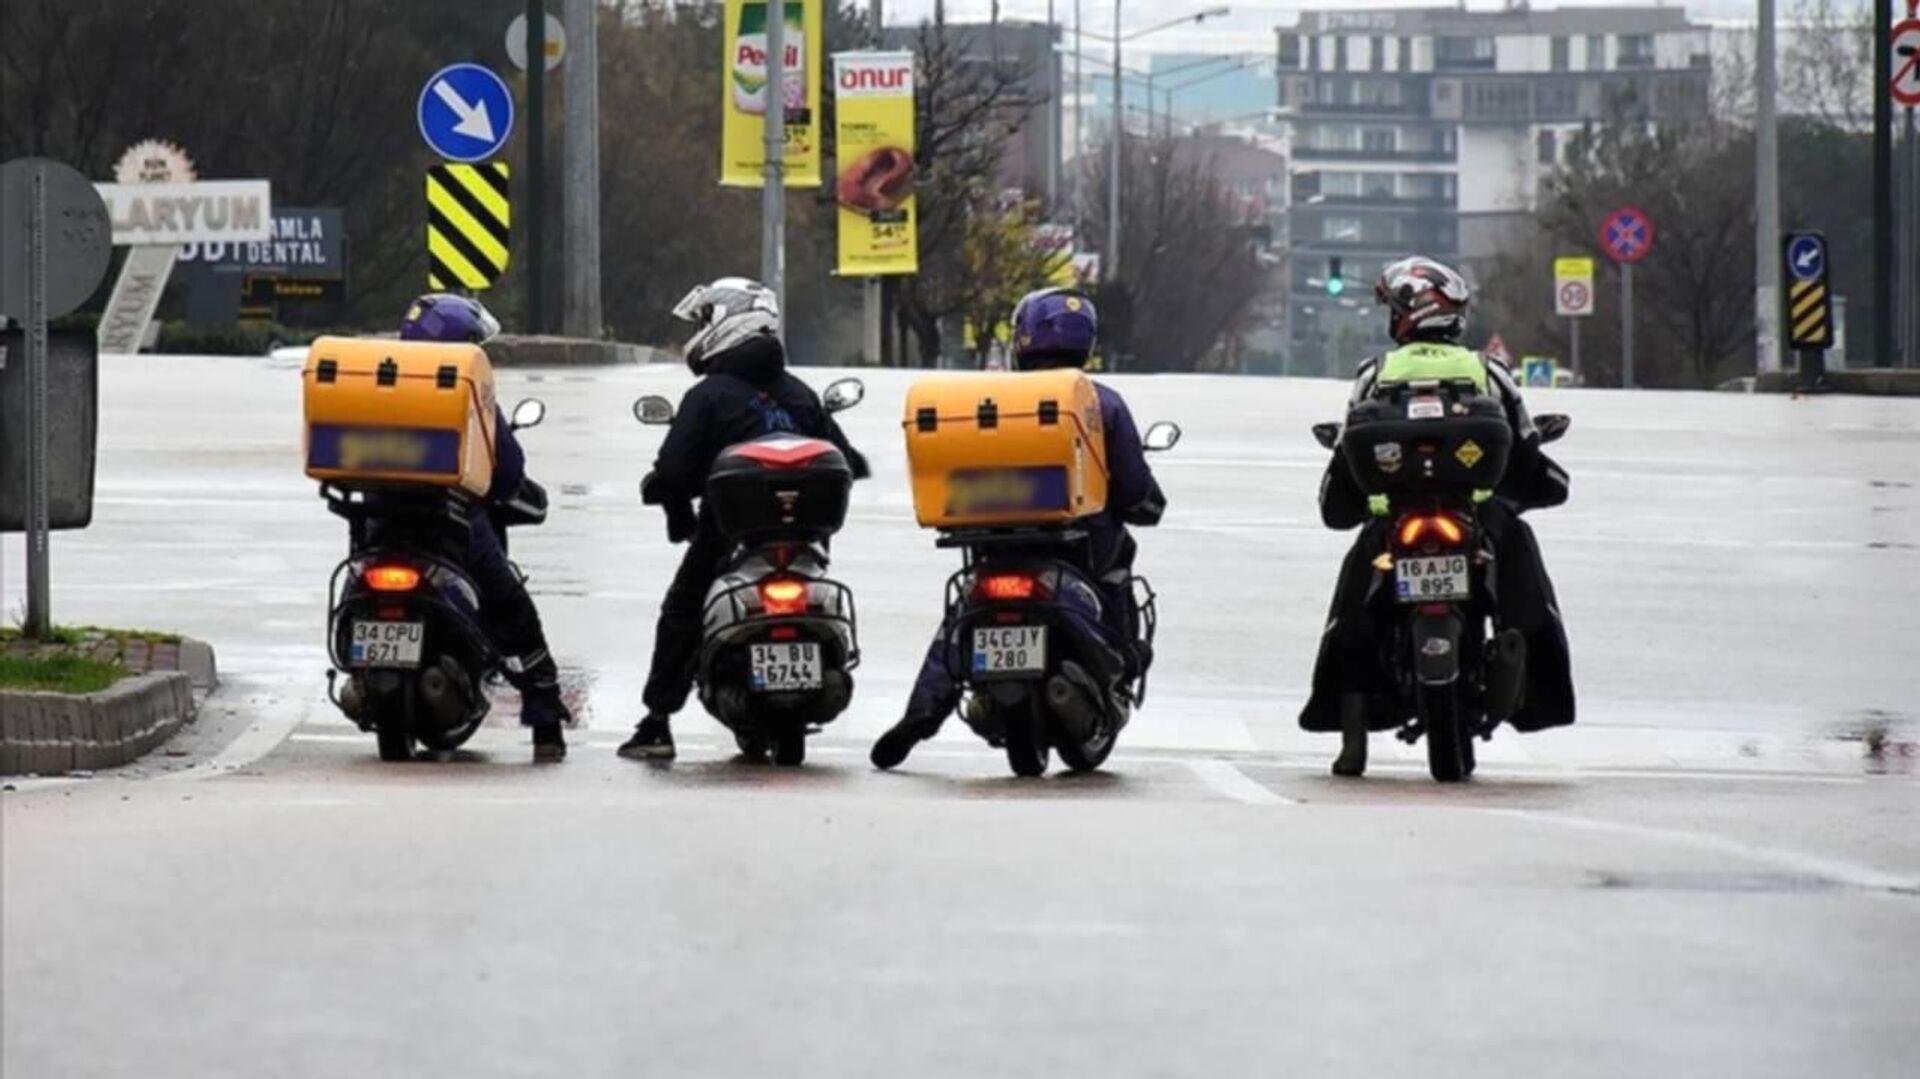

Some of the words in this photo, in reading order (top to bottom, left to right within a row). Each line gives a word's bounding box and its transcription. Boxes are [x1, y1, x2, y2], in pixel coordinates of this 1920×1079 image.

[738, 45, 798, 67] Peil
[841, 67, 909, 89] onur
[248, 242, 326, 263] DENTAL
[1401, 560, 1422, 577] 16
[357, 624, 378, 640] 34
[384, 624, 420, 642] CPU
[368, 643, 399, 661] 671
[754, 645, 777, 664] 34
[994, 649, 1027, 668] 280
[767, 664, 812, 682] 6744
